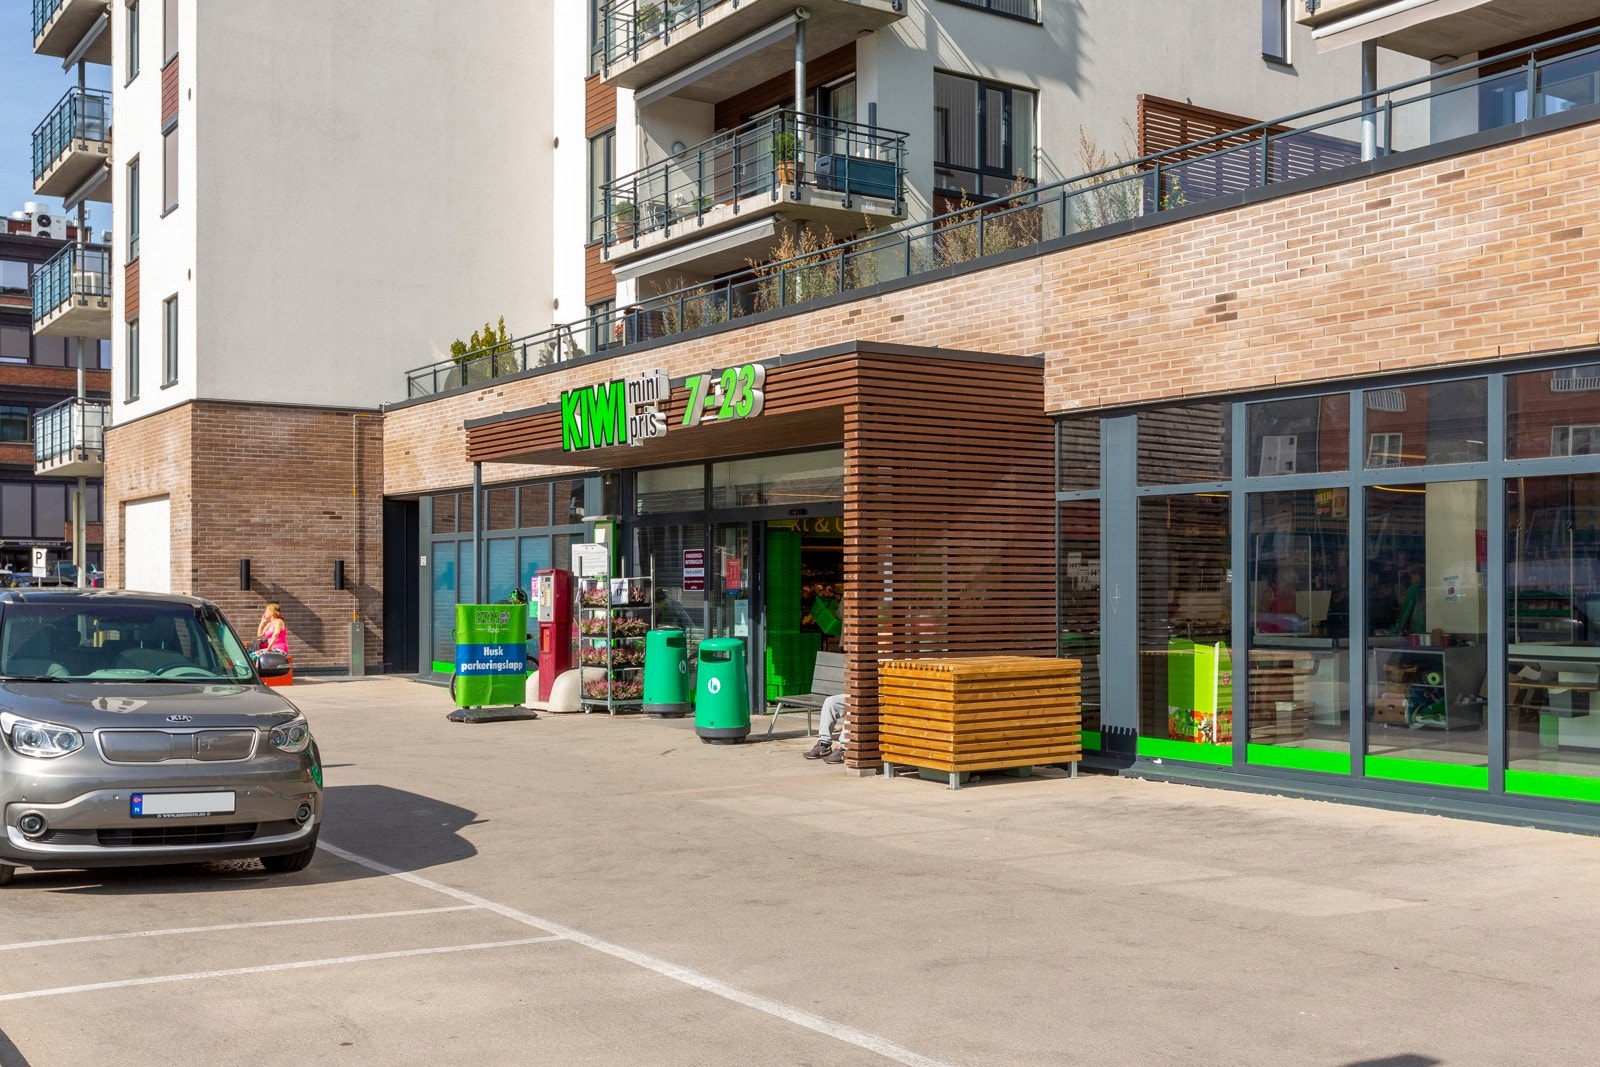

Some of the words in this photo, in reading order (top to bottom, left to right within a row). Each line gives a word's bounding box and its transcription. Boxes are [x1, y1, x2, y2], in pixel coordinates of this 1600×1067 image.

[628, 368, 660, 404] mini
[681, 363, 756, 426] 7-23
[560, 378, 628, 452] KIWI
[630, 407, 657, 444] pris
[36, 552, 43, 565] P
[460, 659, 523, 673] parkeringslapp
[483, 645, 504, 656] Husk
